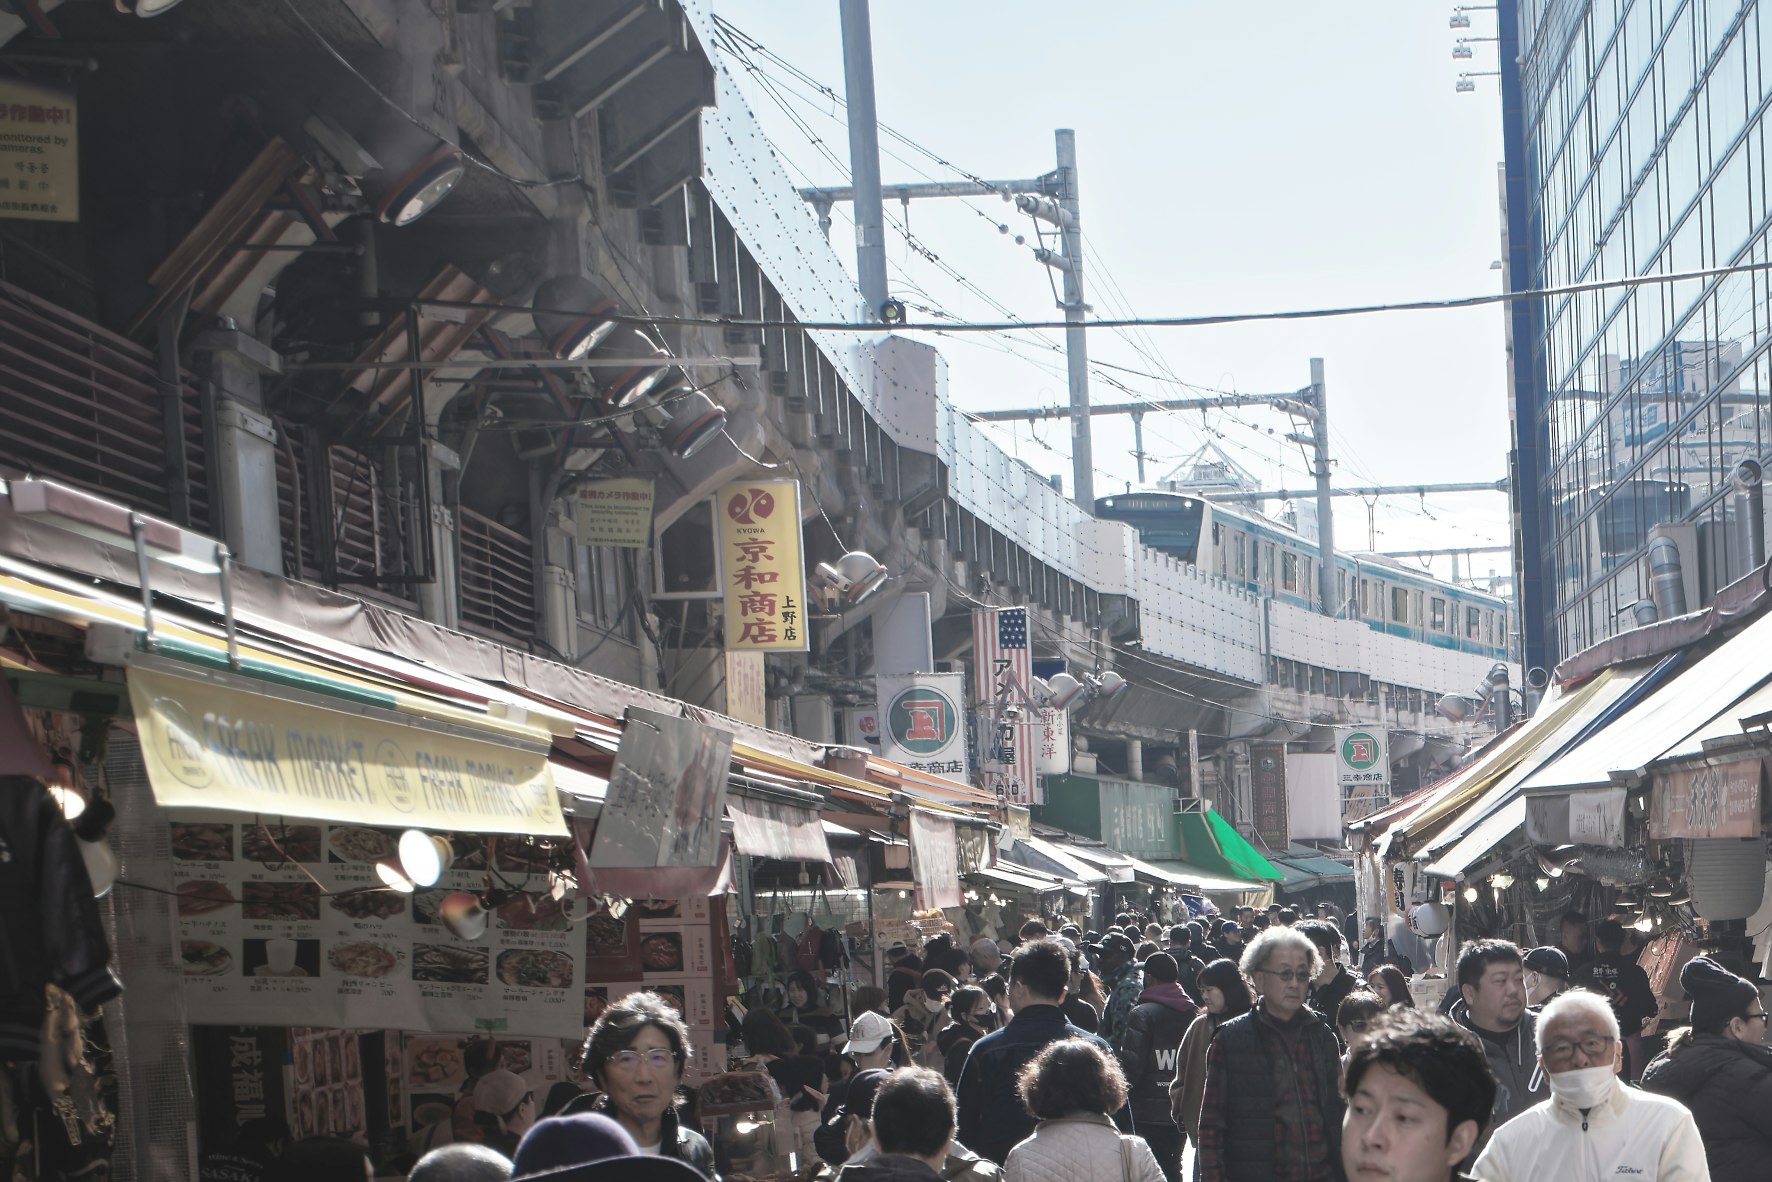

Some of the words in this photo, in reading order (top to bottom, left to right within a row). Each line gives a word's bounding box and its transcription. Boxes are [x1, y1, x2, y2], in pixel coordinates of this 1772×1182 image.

[732, 537, 779, 644] 京和商店
[781, 595, 796, 641] 上野店
[1040, 709, 1057, 760] 新東洋
